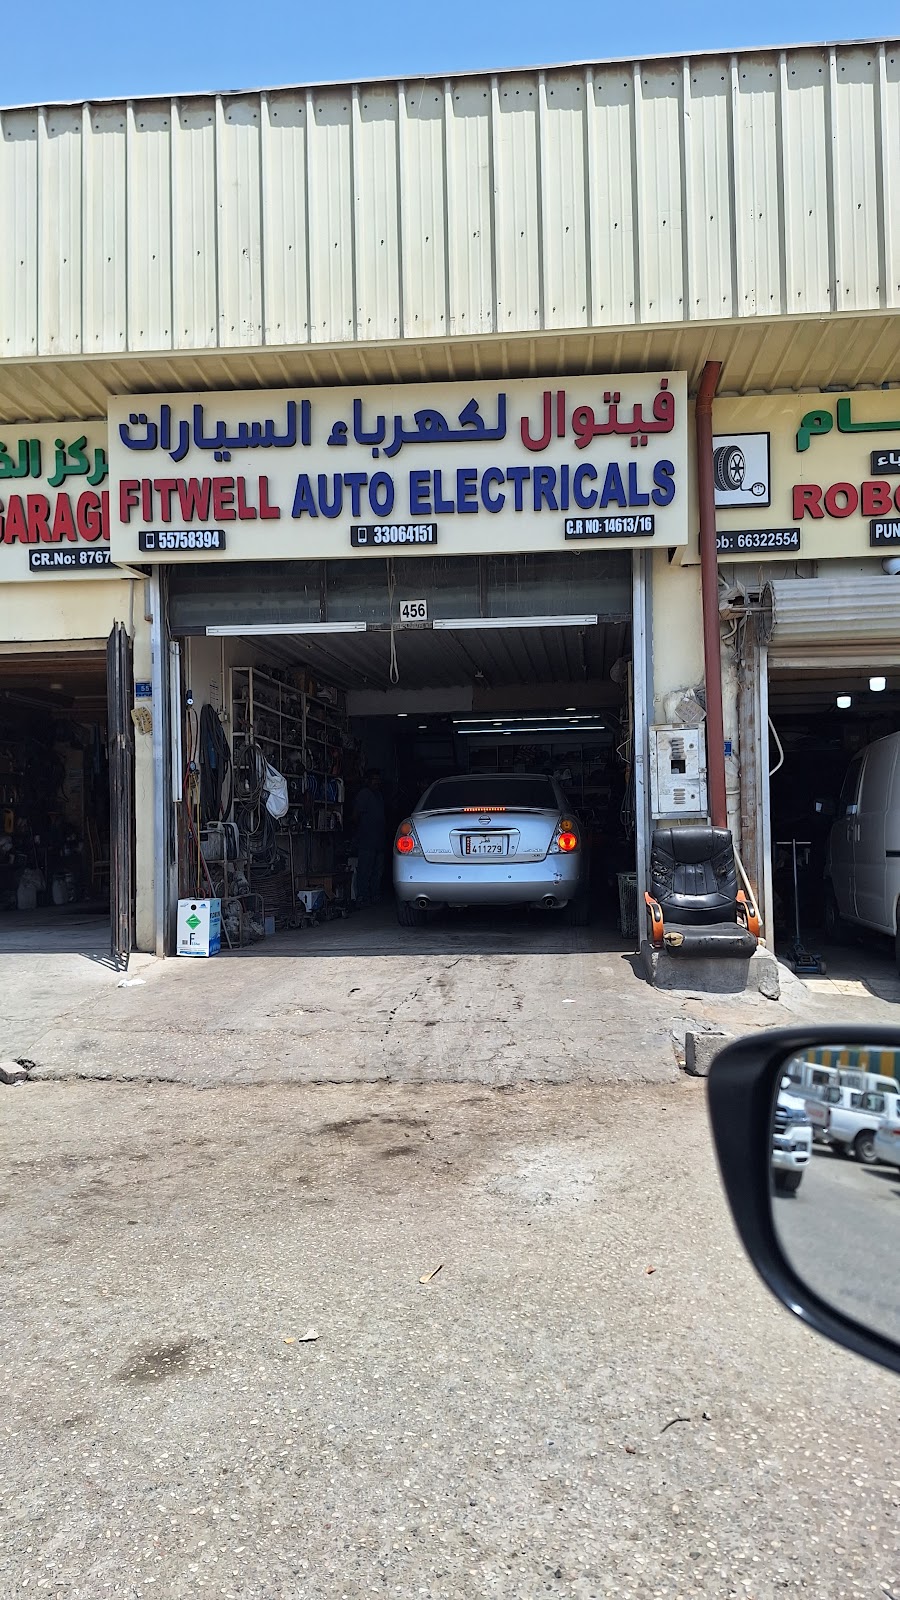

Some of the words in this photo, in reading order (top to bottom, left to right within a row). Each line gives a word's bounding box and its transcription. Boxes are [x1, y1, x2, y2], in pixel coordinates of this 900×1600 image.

[521, 379, 676, 452] فيتوال
[119, 399, 312, 463] السيارات
[327, 393, 507, 459] لكهرباء
[47, 435, 109, 488] ركز
[119, 475, 281, 524] FITWELL
[291, 471, 395, 519] AUTO
[409, 459, 676, 516] ELECTRICALS
[792, 480, 900, 521] ROB
[373, 524, 434, 544] 33064151
[566, 520, 583, 535] C.R
[585, 518, 603, 534] NO:
[603, 515, 653, 534] 14613/16
[158, 530, 220, 549] 55758394
[715, 535, 733, 549] ob:
[737, 531, 799, 548] 66322554
[31, 552, 76, 566] CR.No:
[402, 603, 426, 618] 456
[472, 845, 503, 853] 411279
